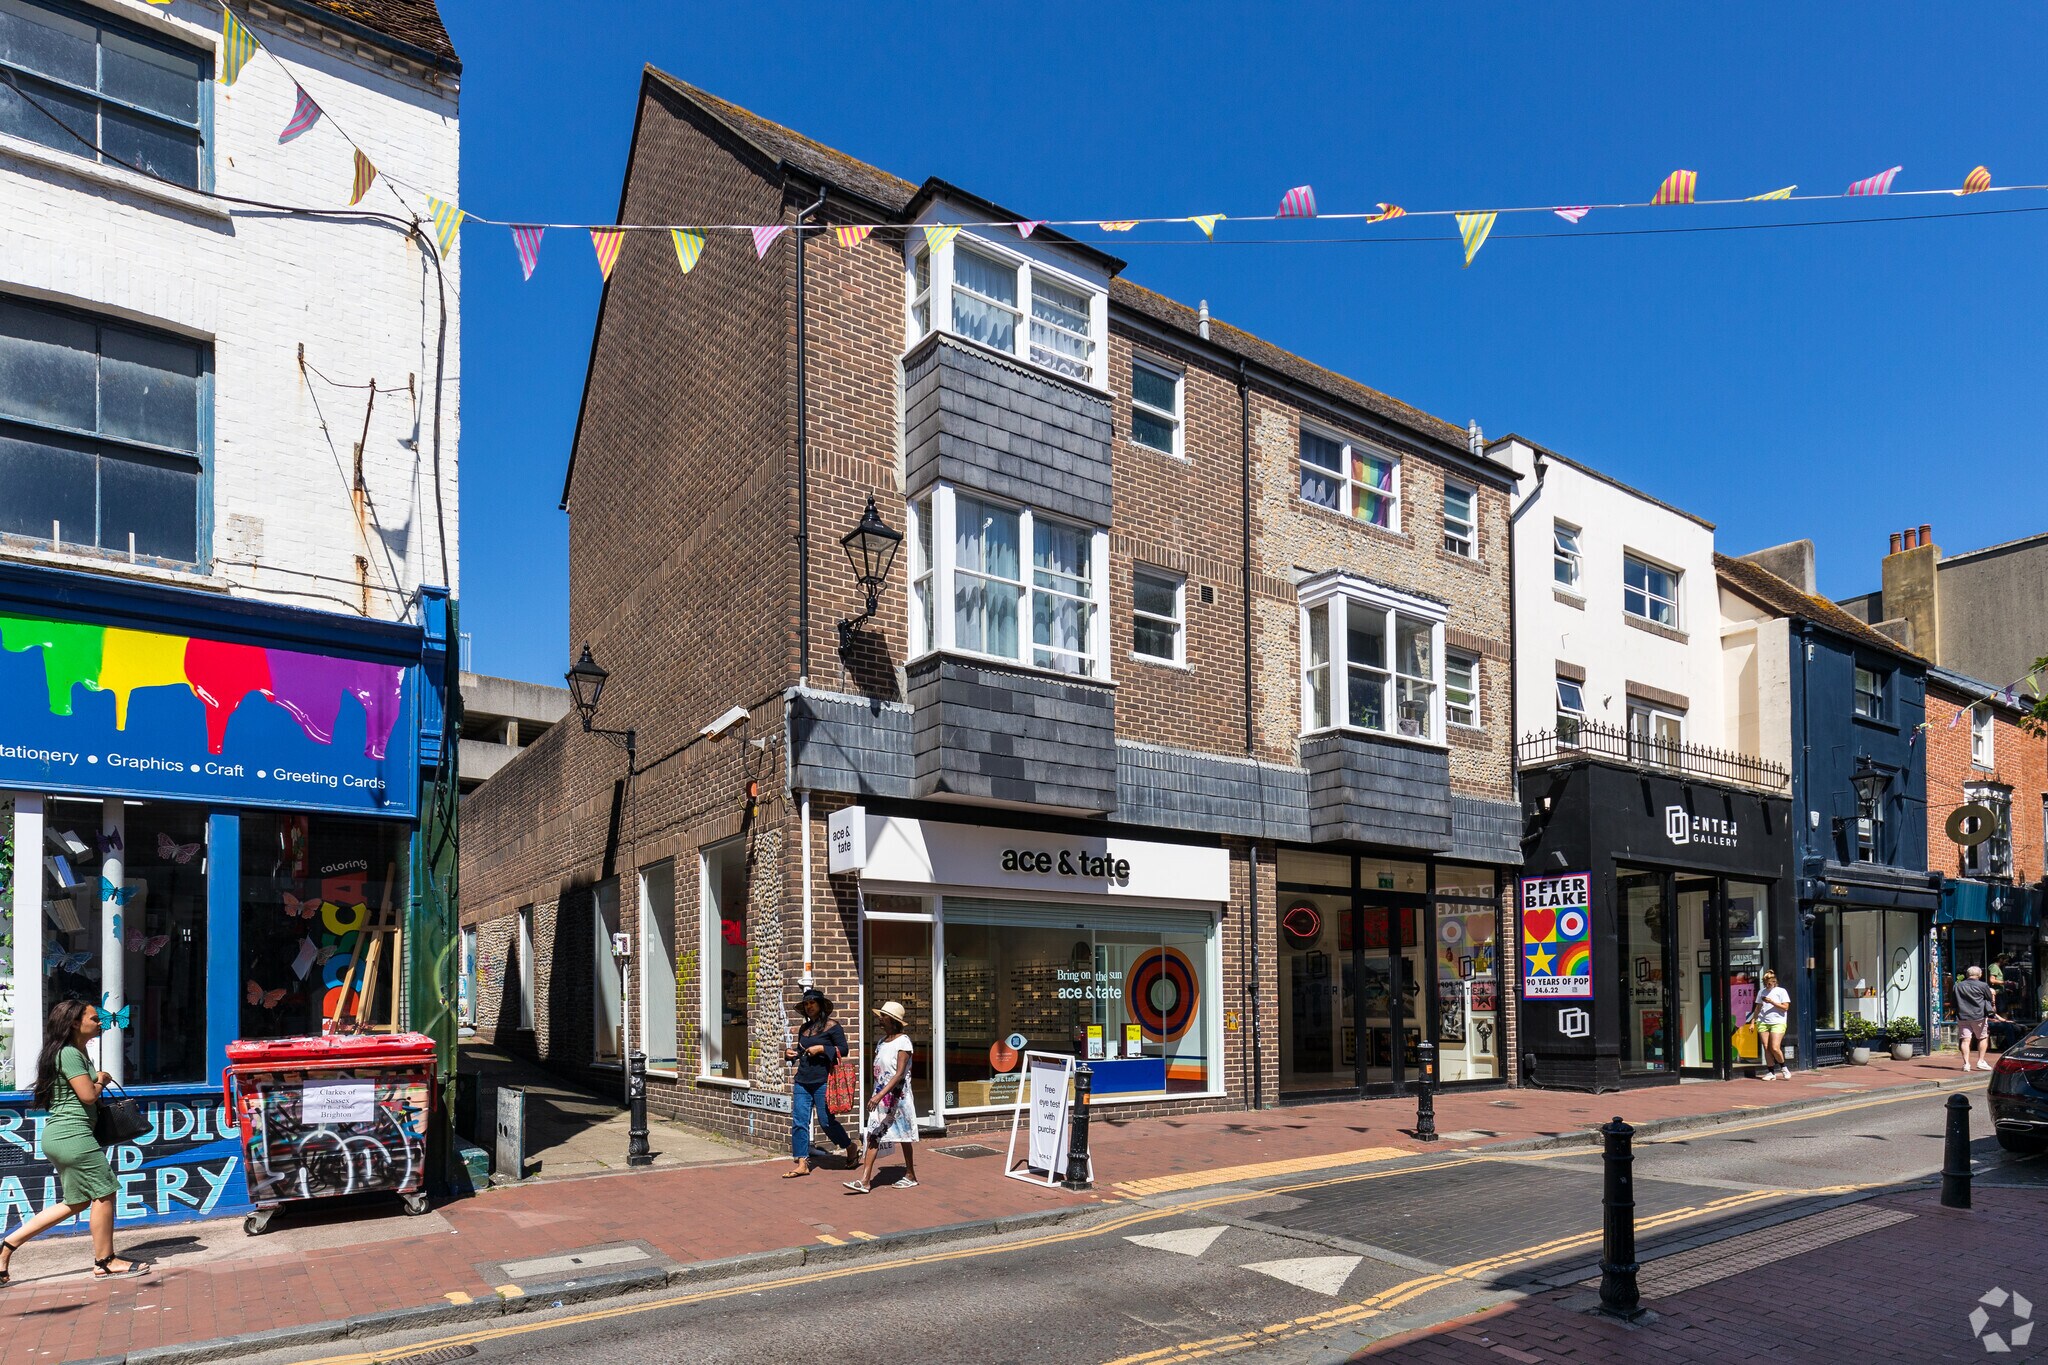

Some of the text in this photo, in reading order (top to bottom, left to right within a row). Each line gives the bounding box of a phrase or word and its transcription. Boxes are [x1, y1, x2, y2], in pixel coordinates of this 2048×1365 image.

[0, 744, 386, 789] tationery Graphics Craft Greeting Cards
[1692, 816, 1738, 835] ENTER
[832, 825, 851, 841] ace &
[1693, 833, 1738, 847] GALLERY
[838, 840, 851, 853] tate
[321, 859, 368, 874] coloring
[1001, 849, 1131, 878] ace & tate
[1525, 878, 1586, 895] PETER
[1525, 891, 1587, 908] BLAKE
[1057, 969, 1123, 983] Bring on the sun
[1526, 978, 1536, 986] 90
[1538, 978, 1560, 986] YEARS
[1058, 985, 1122, 999] ace & tate
[1044, 1084, 1056, 1095] free
[732, 1091, 746, 1103] BOND
[746, 1093, 765, 1106] STREET
[1039, 1099, 1061, 1109] eye test
[320, 1111, 352, 1119] Brighton
[1043, 1112, 1056, 1122] with
[1037, 1125, 1056, 1135] purcha
